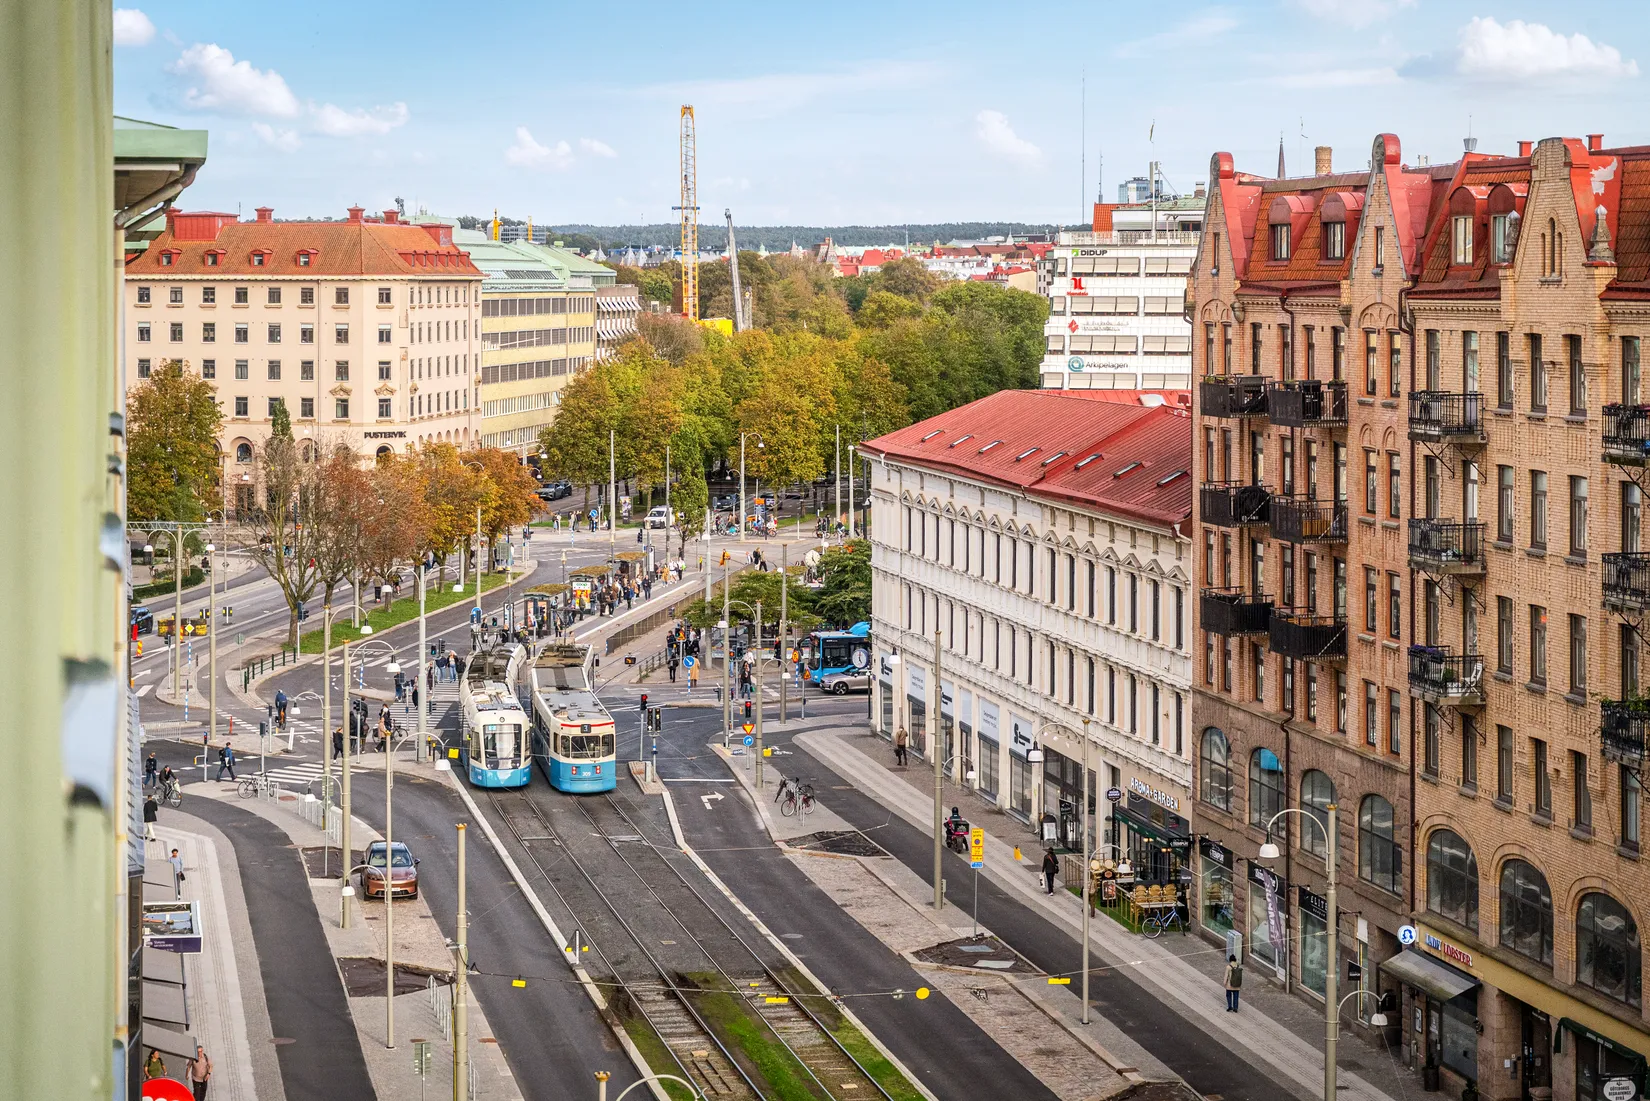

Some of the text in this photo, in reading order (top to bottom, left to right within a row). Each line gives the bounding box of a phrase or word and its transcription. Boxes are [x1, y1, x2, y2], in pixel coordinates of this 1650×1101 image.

[1086, 361, 1128, 370] Arkipelagen
[364, 431, 407, 439] PUSTERVIK
[1444, 942, 1473, 967] LOBSTER
